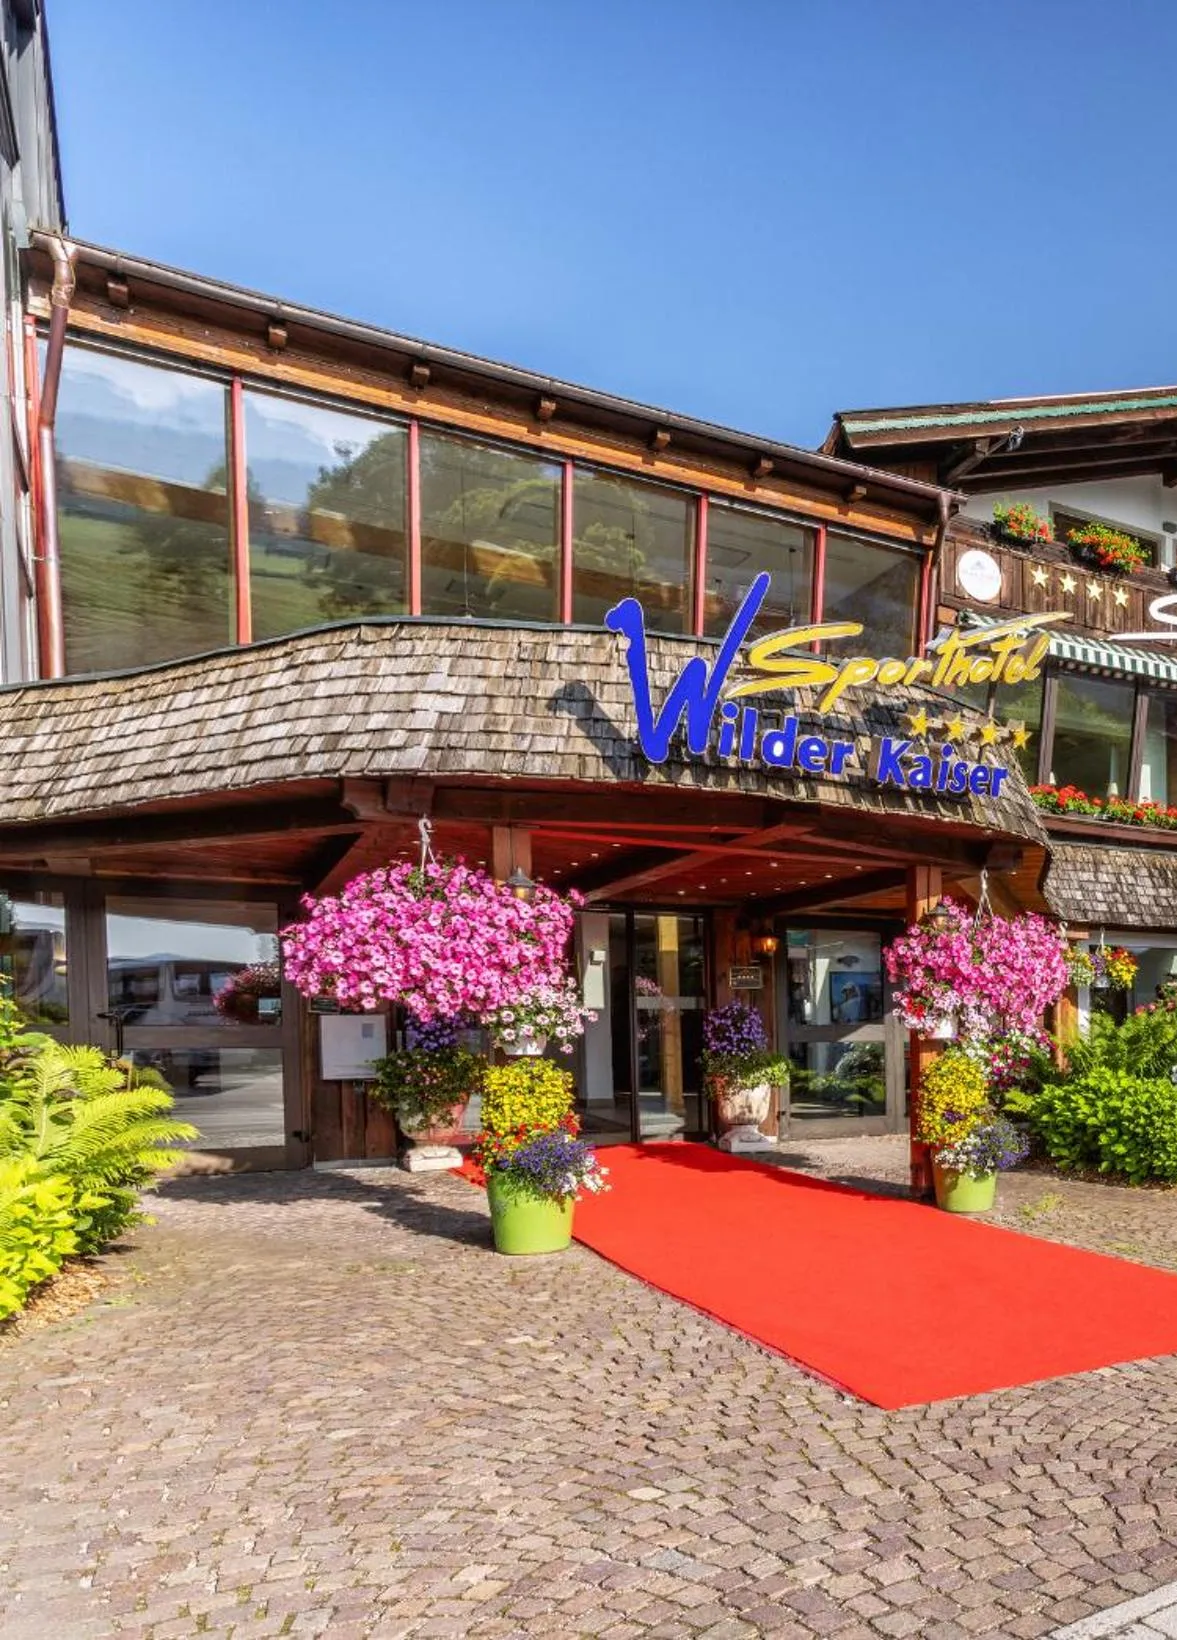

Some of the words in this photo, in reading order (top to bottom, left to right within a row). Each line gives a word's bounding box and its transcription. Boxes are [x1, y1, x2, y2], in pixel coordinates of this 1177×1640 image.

[604, 571, 856, 775] Wilder
[876, 737, 1008, 799] Kaiser
[722, 611, 1074, 713] Sporthotel
